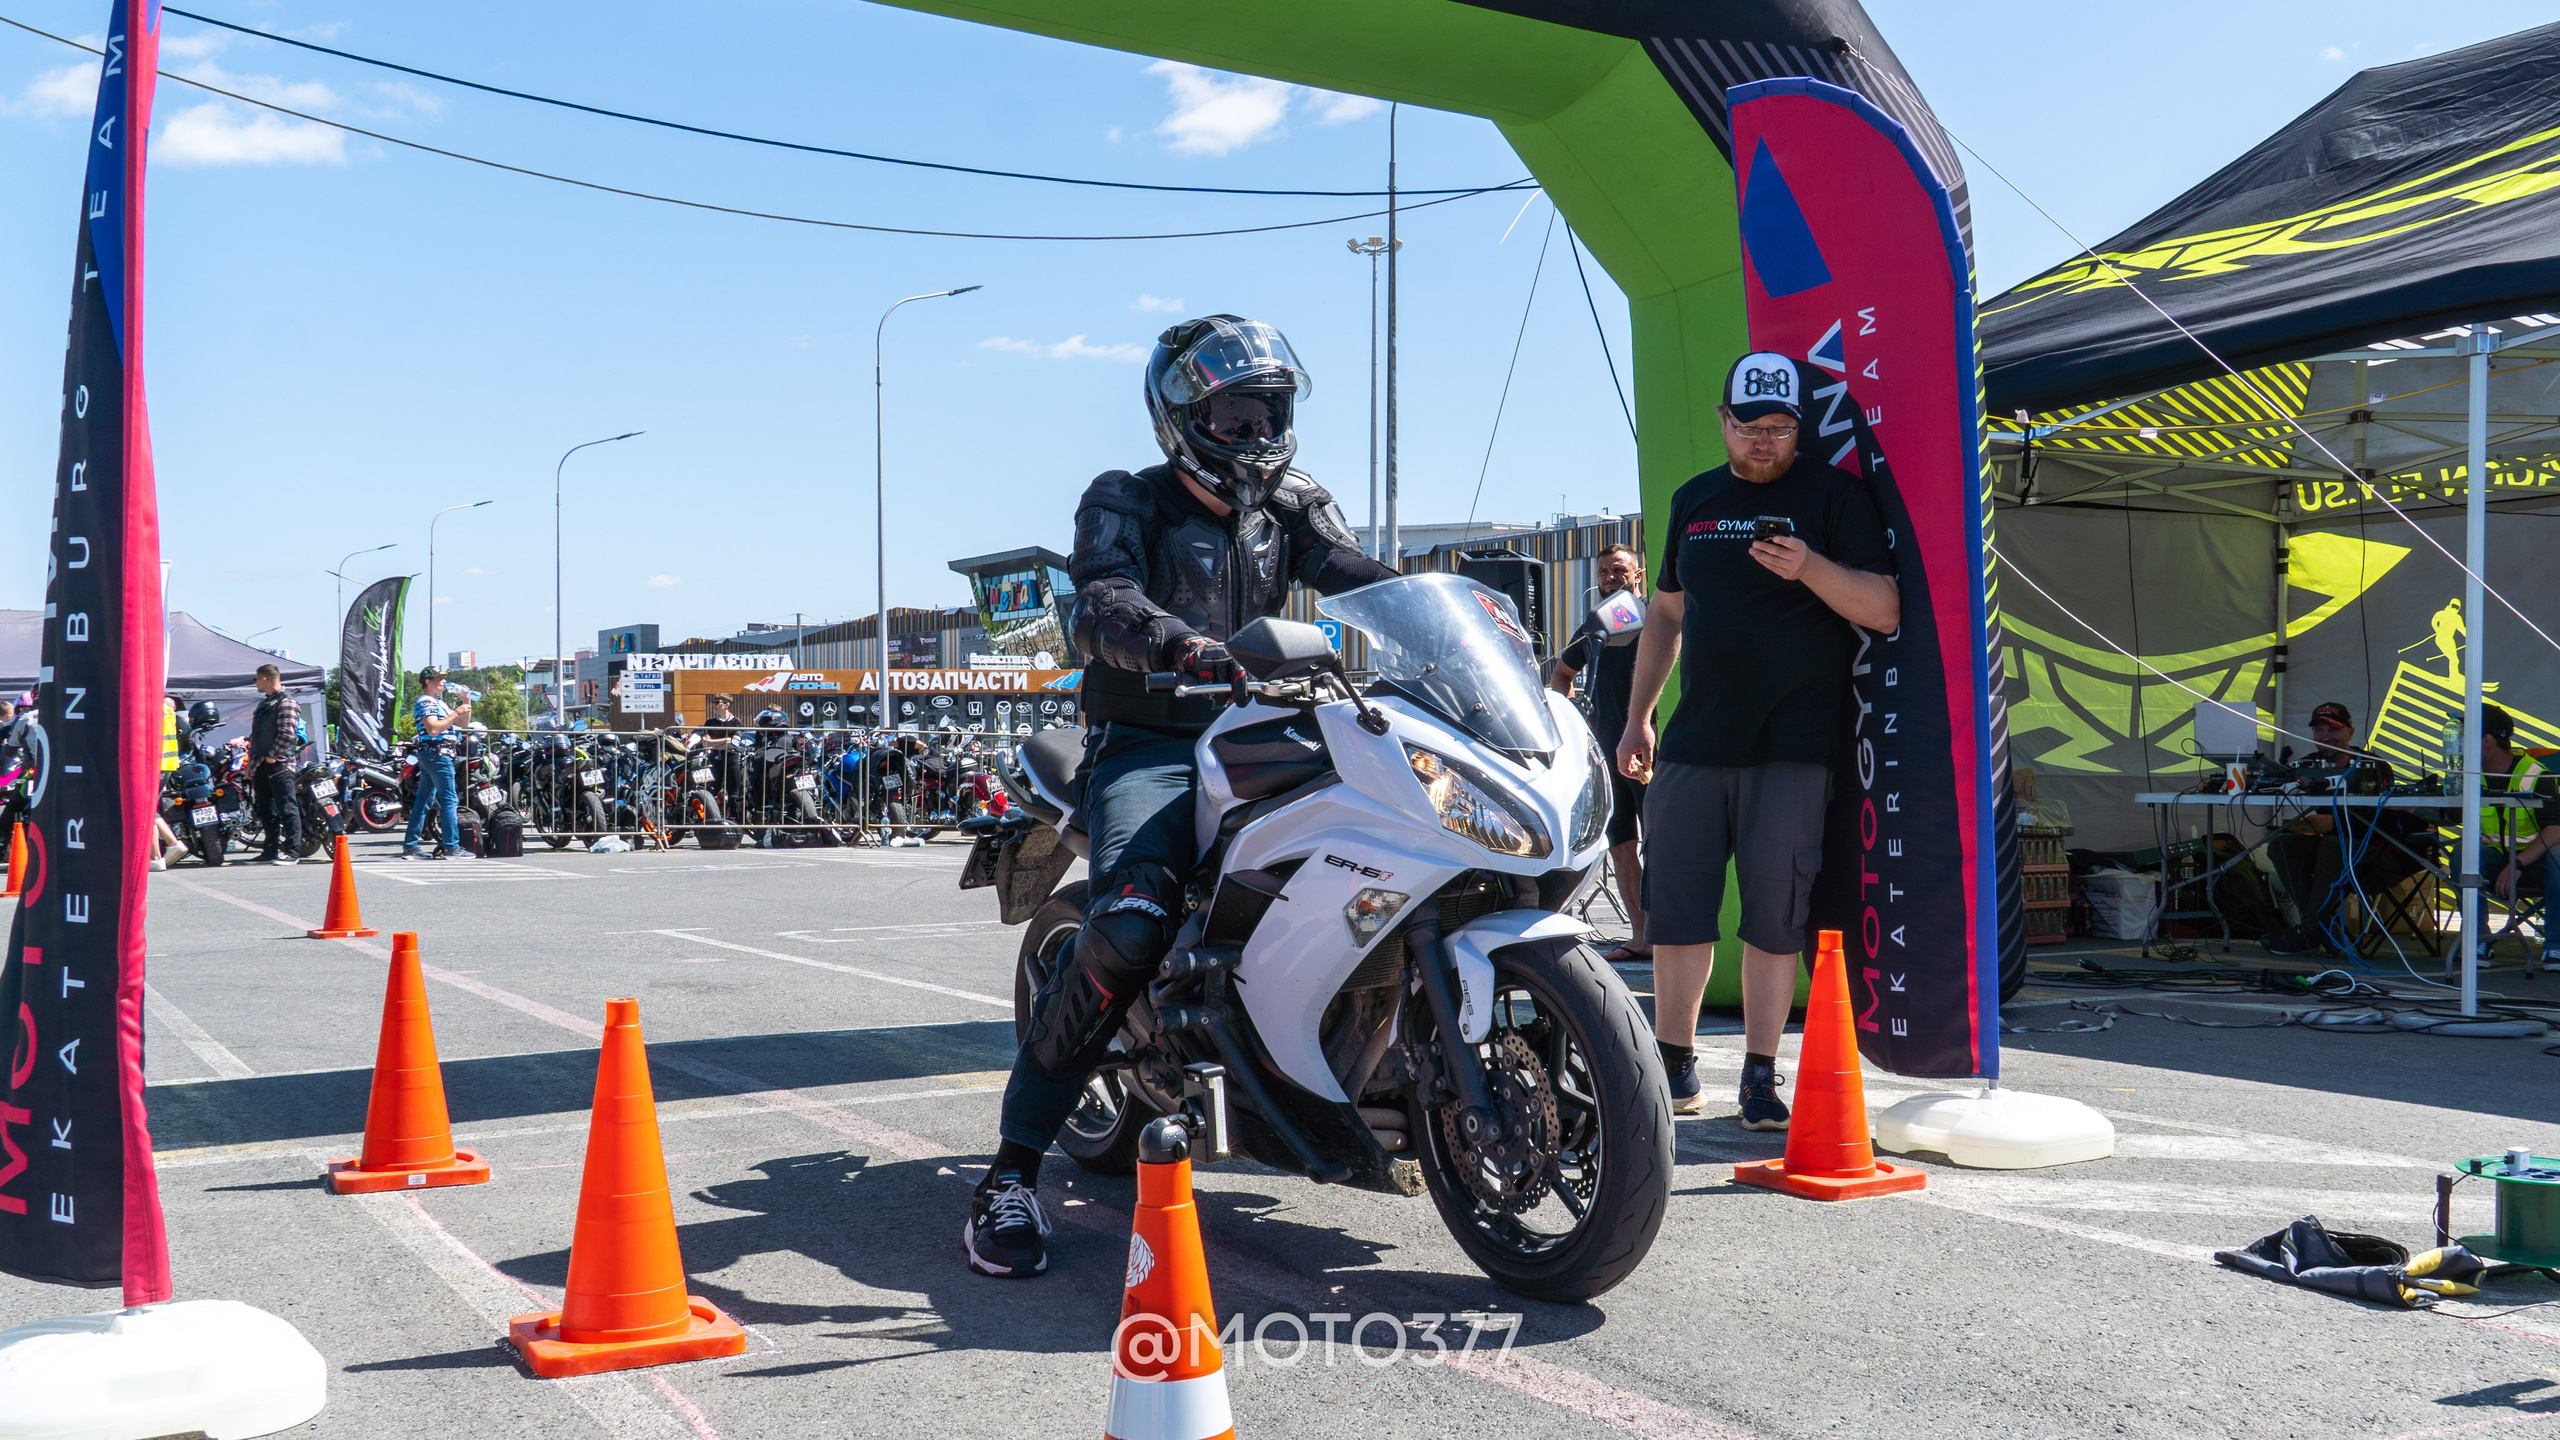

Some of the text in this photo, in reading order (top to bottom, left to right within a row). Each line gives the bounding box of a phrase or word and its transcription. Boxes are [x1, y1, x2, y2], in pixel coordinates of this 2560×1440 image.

[1858, 306, 1886, 472] TEAM
[1687, 519, 1795, 533] MOTOGYMK
[51, 33, 125, 1225] EKATERINBURG TEAM
[788, 682, 840, 690] ЯПОНЕЦ
[790, 673, 824, 681] АВТО
[859, 672, 1028, 691] АТОЗАПЧАСТИ
[1283, 726, 1322, 752] Kawasaki
[1461, 979, 1475, 1016] ABS
